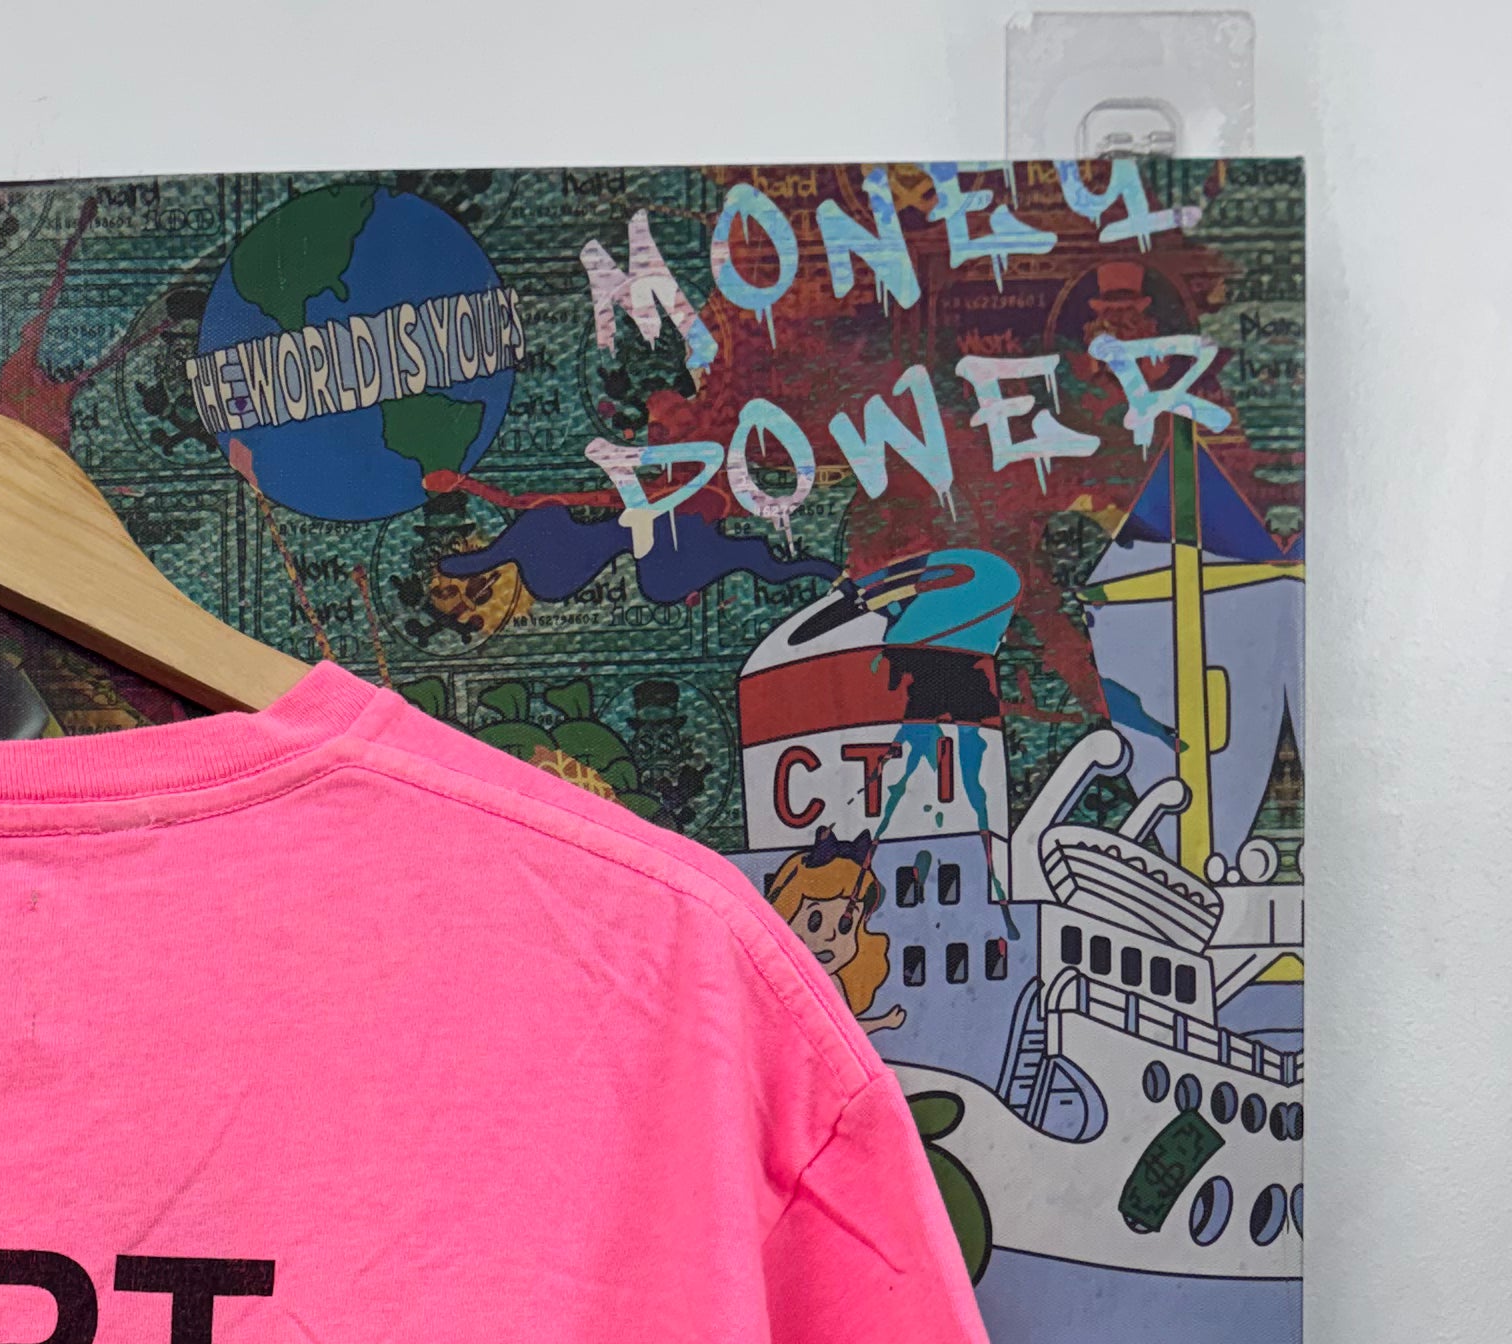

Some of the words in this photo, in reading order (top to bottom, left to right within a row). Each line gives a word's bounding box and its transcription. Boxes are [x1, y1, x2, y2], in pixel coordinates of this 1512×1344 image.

[185, 345, 245, 434] THE
[238, 316, 382, 427] WORLD
[384, 302, 428, 401] IS
[420, 287, 525, 389] YOURS
[584, 333, 1232, 560] POWER
